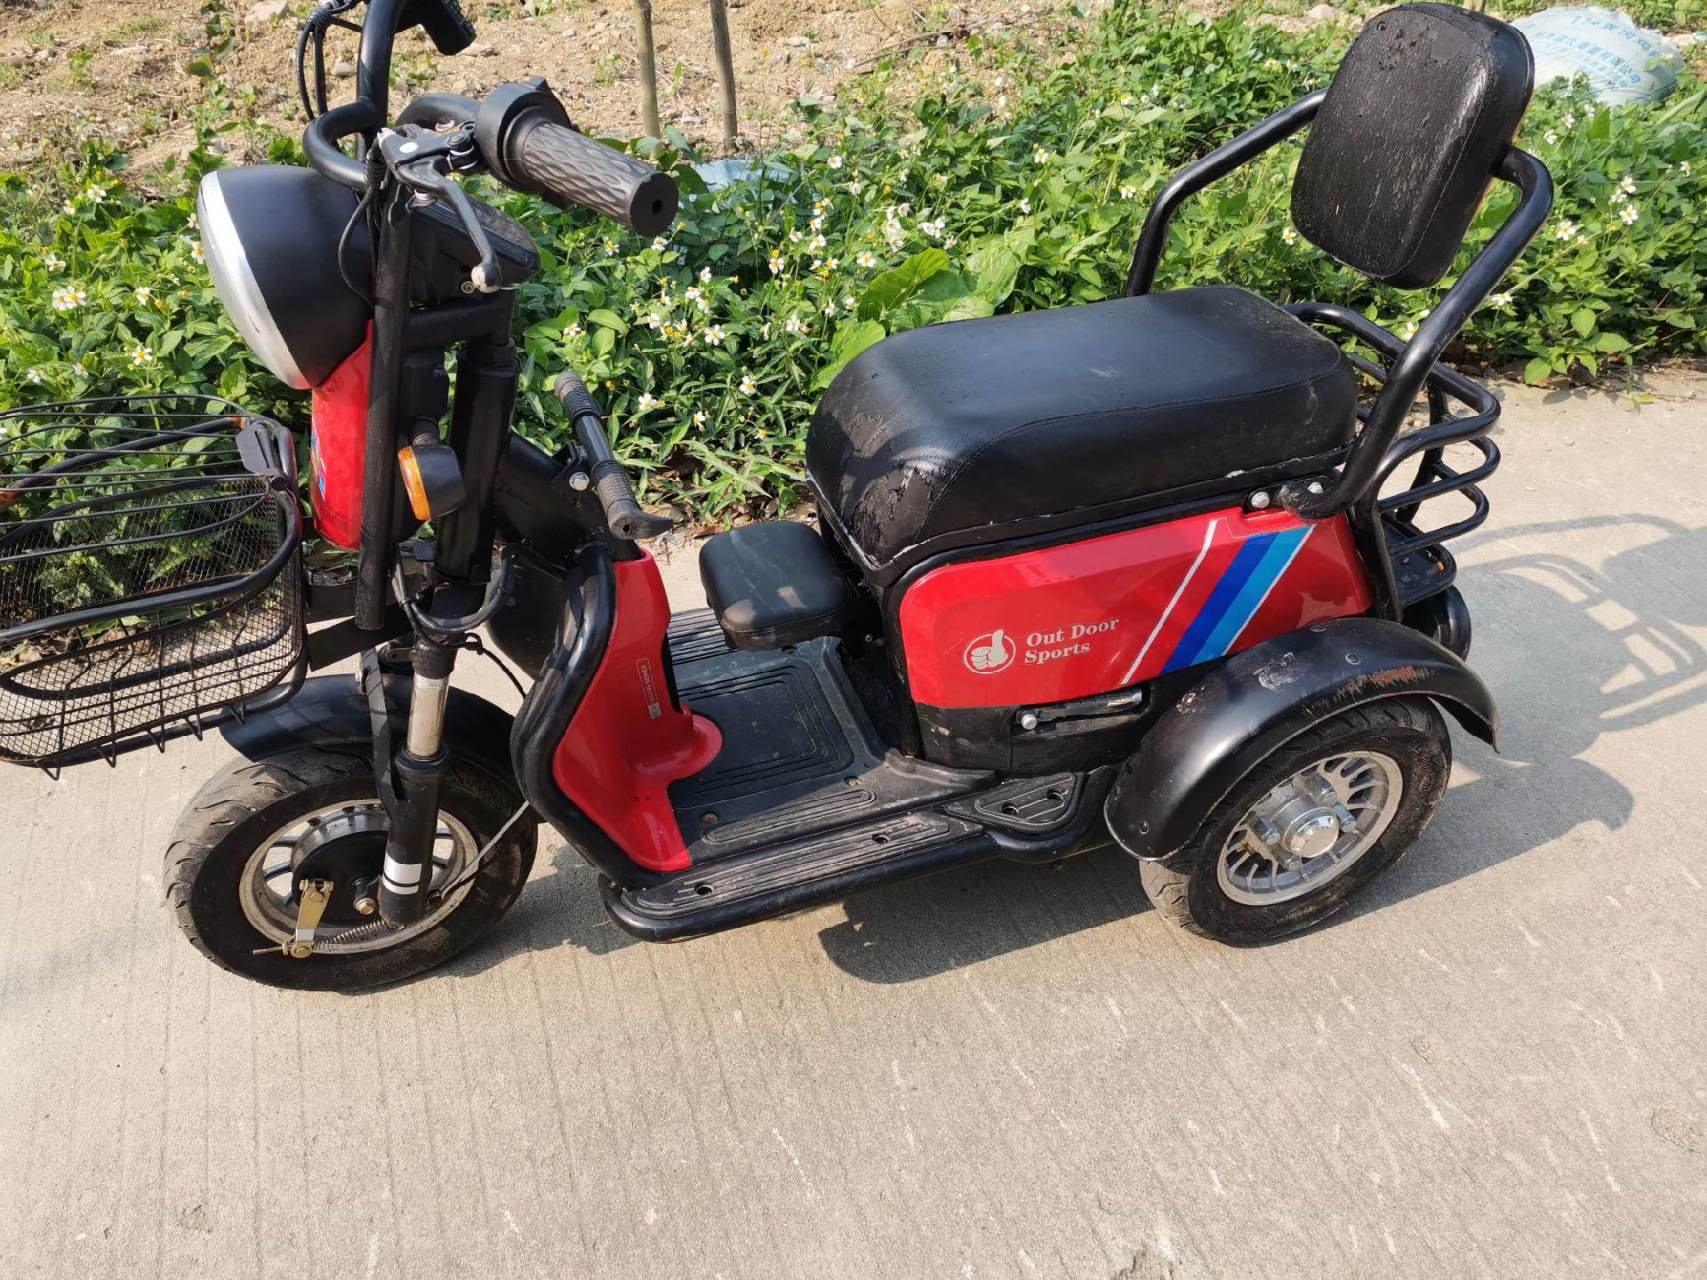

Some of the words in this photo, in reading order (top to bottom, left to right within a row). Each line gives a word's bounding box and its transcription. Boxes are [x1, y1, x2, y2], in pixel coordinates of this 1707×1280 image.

[1026, 629, 1065, 647] Out
[1071, 618, 1120, 639] Door
[1025, 642, 1091, 665] Sports
